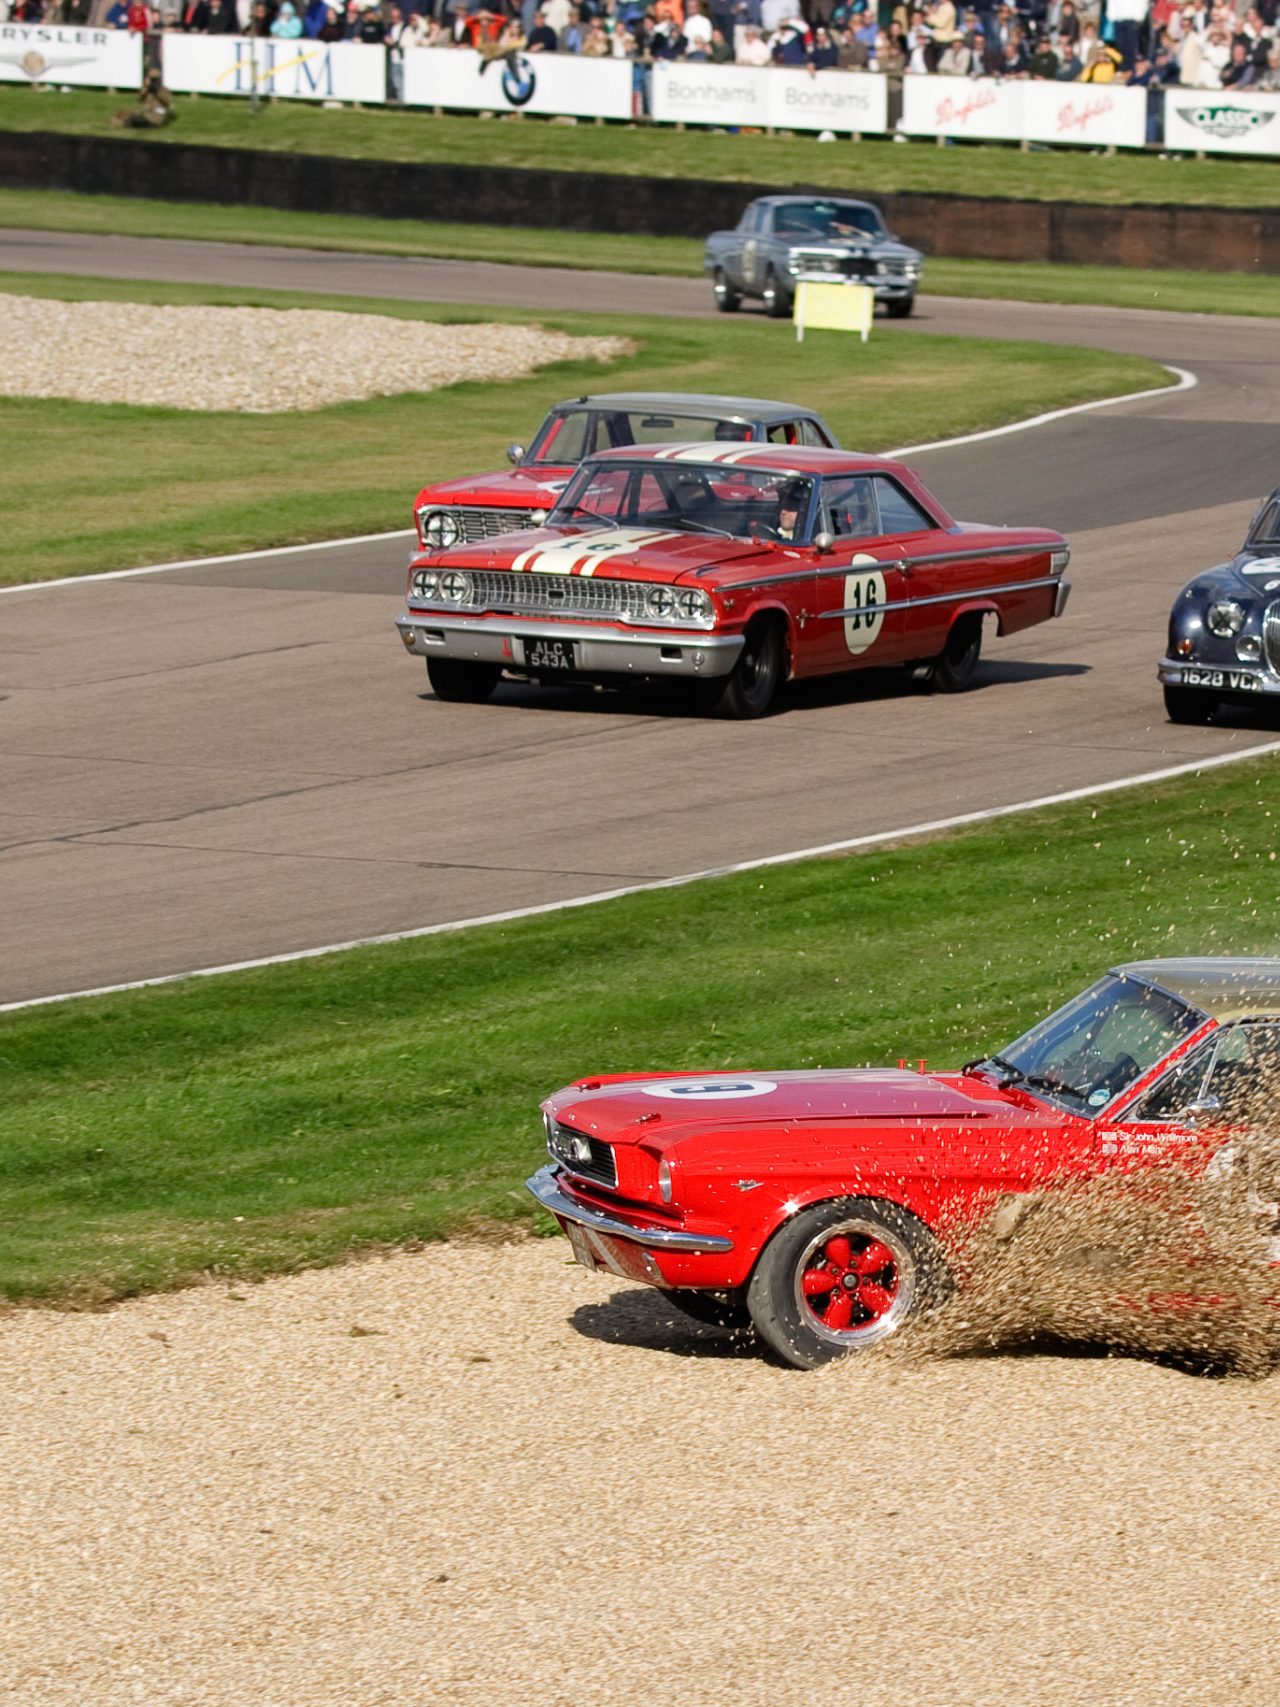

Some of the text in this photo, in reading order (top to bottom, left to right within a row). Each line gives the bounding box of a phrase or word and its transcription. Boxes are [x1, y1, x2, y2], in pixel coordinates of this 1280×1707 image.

[667, 80, 758, 104] Bonhams
[784, 86, 871, 111] Bonhams
[1192, 107, 1265, 129] CLASSIC
[852, 578, 877, 631] 16
[535, 641, 564, 656] ALC
[530, 652, 569, 669] 543A
[1182, 668, 1224, 687] 1628
